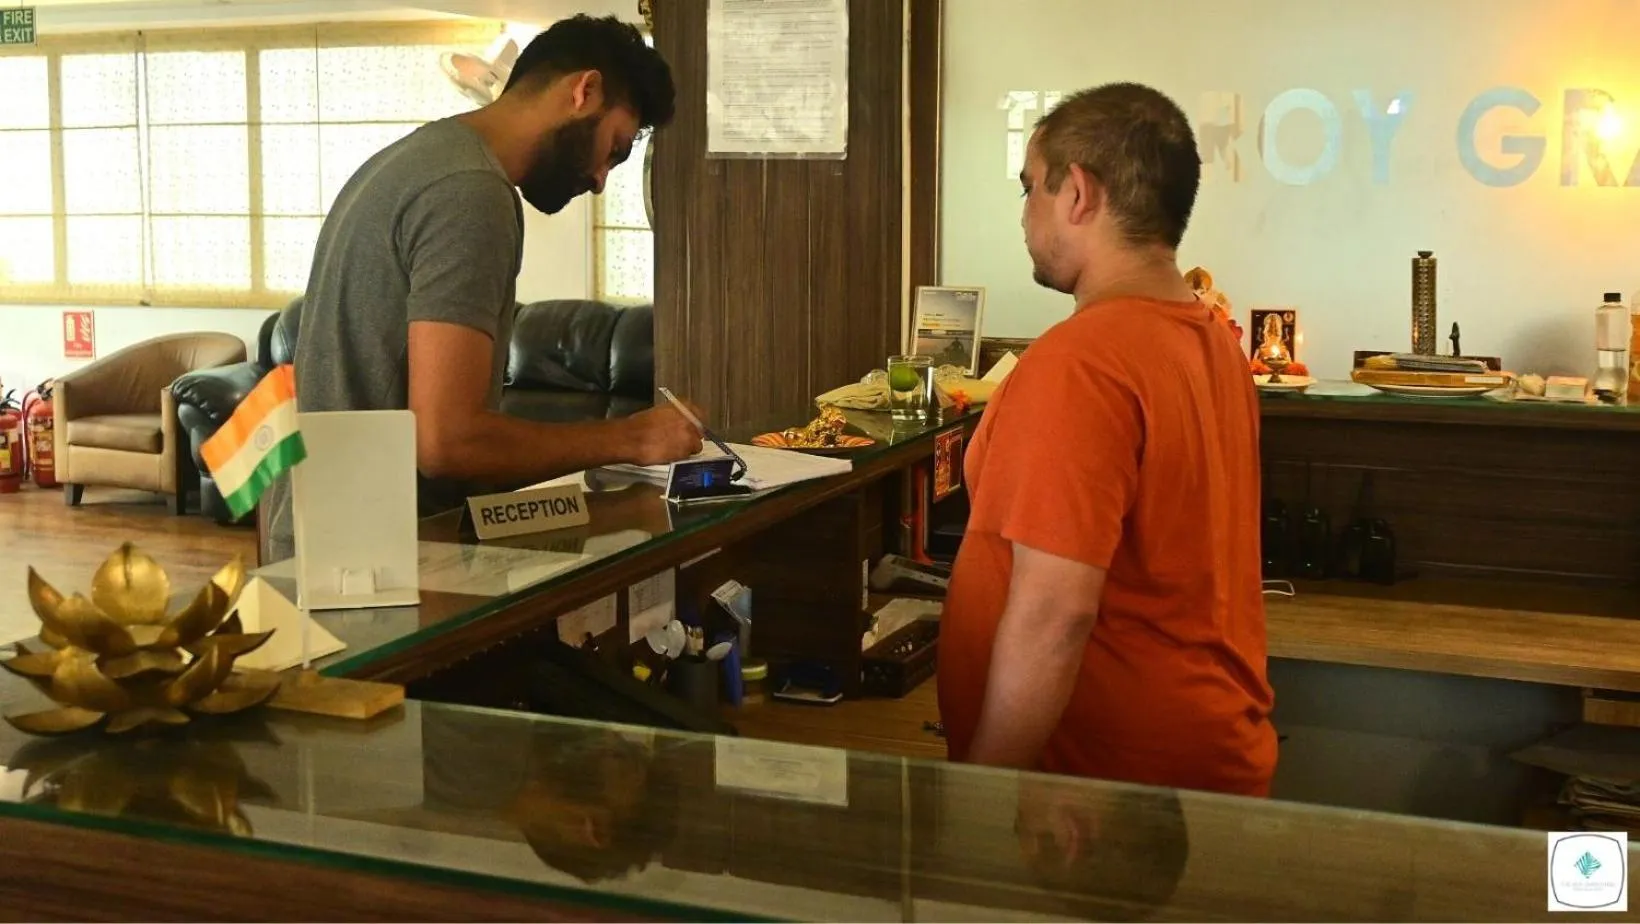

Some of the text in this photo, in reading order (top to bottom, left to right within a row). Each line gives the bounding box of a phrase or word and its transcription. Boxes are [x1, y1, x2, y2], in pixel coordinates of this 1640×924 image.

[3, 10, 32, 25] FIRE
[4, 28, 32, 42] EXIT
[481, 496, 579, 526] RECEPTION
